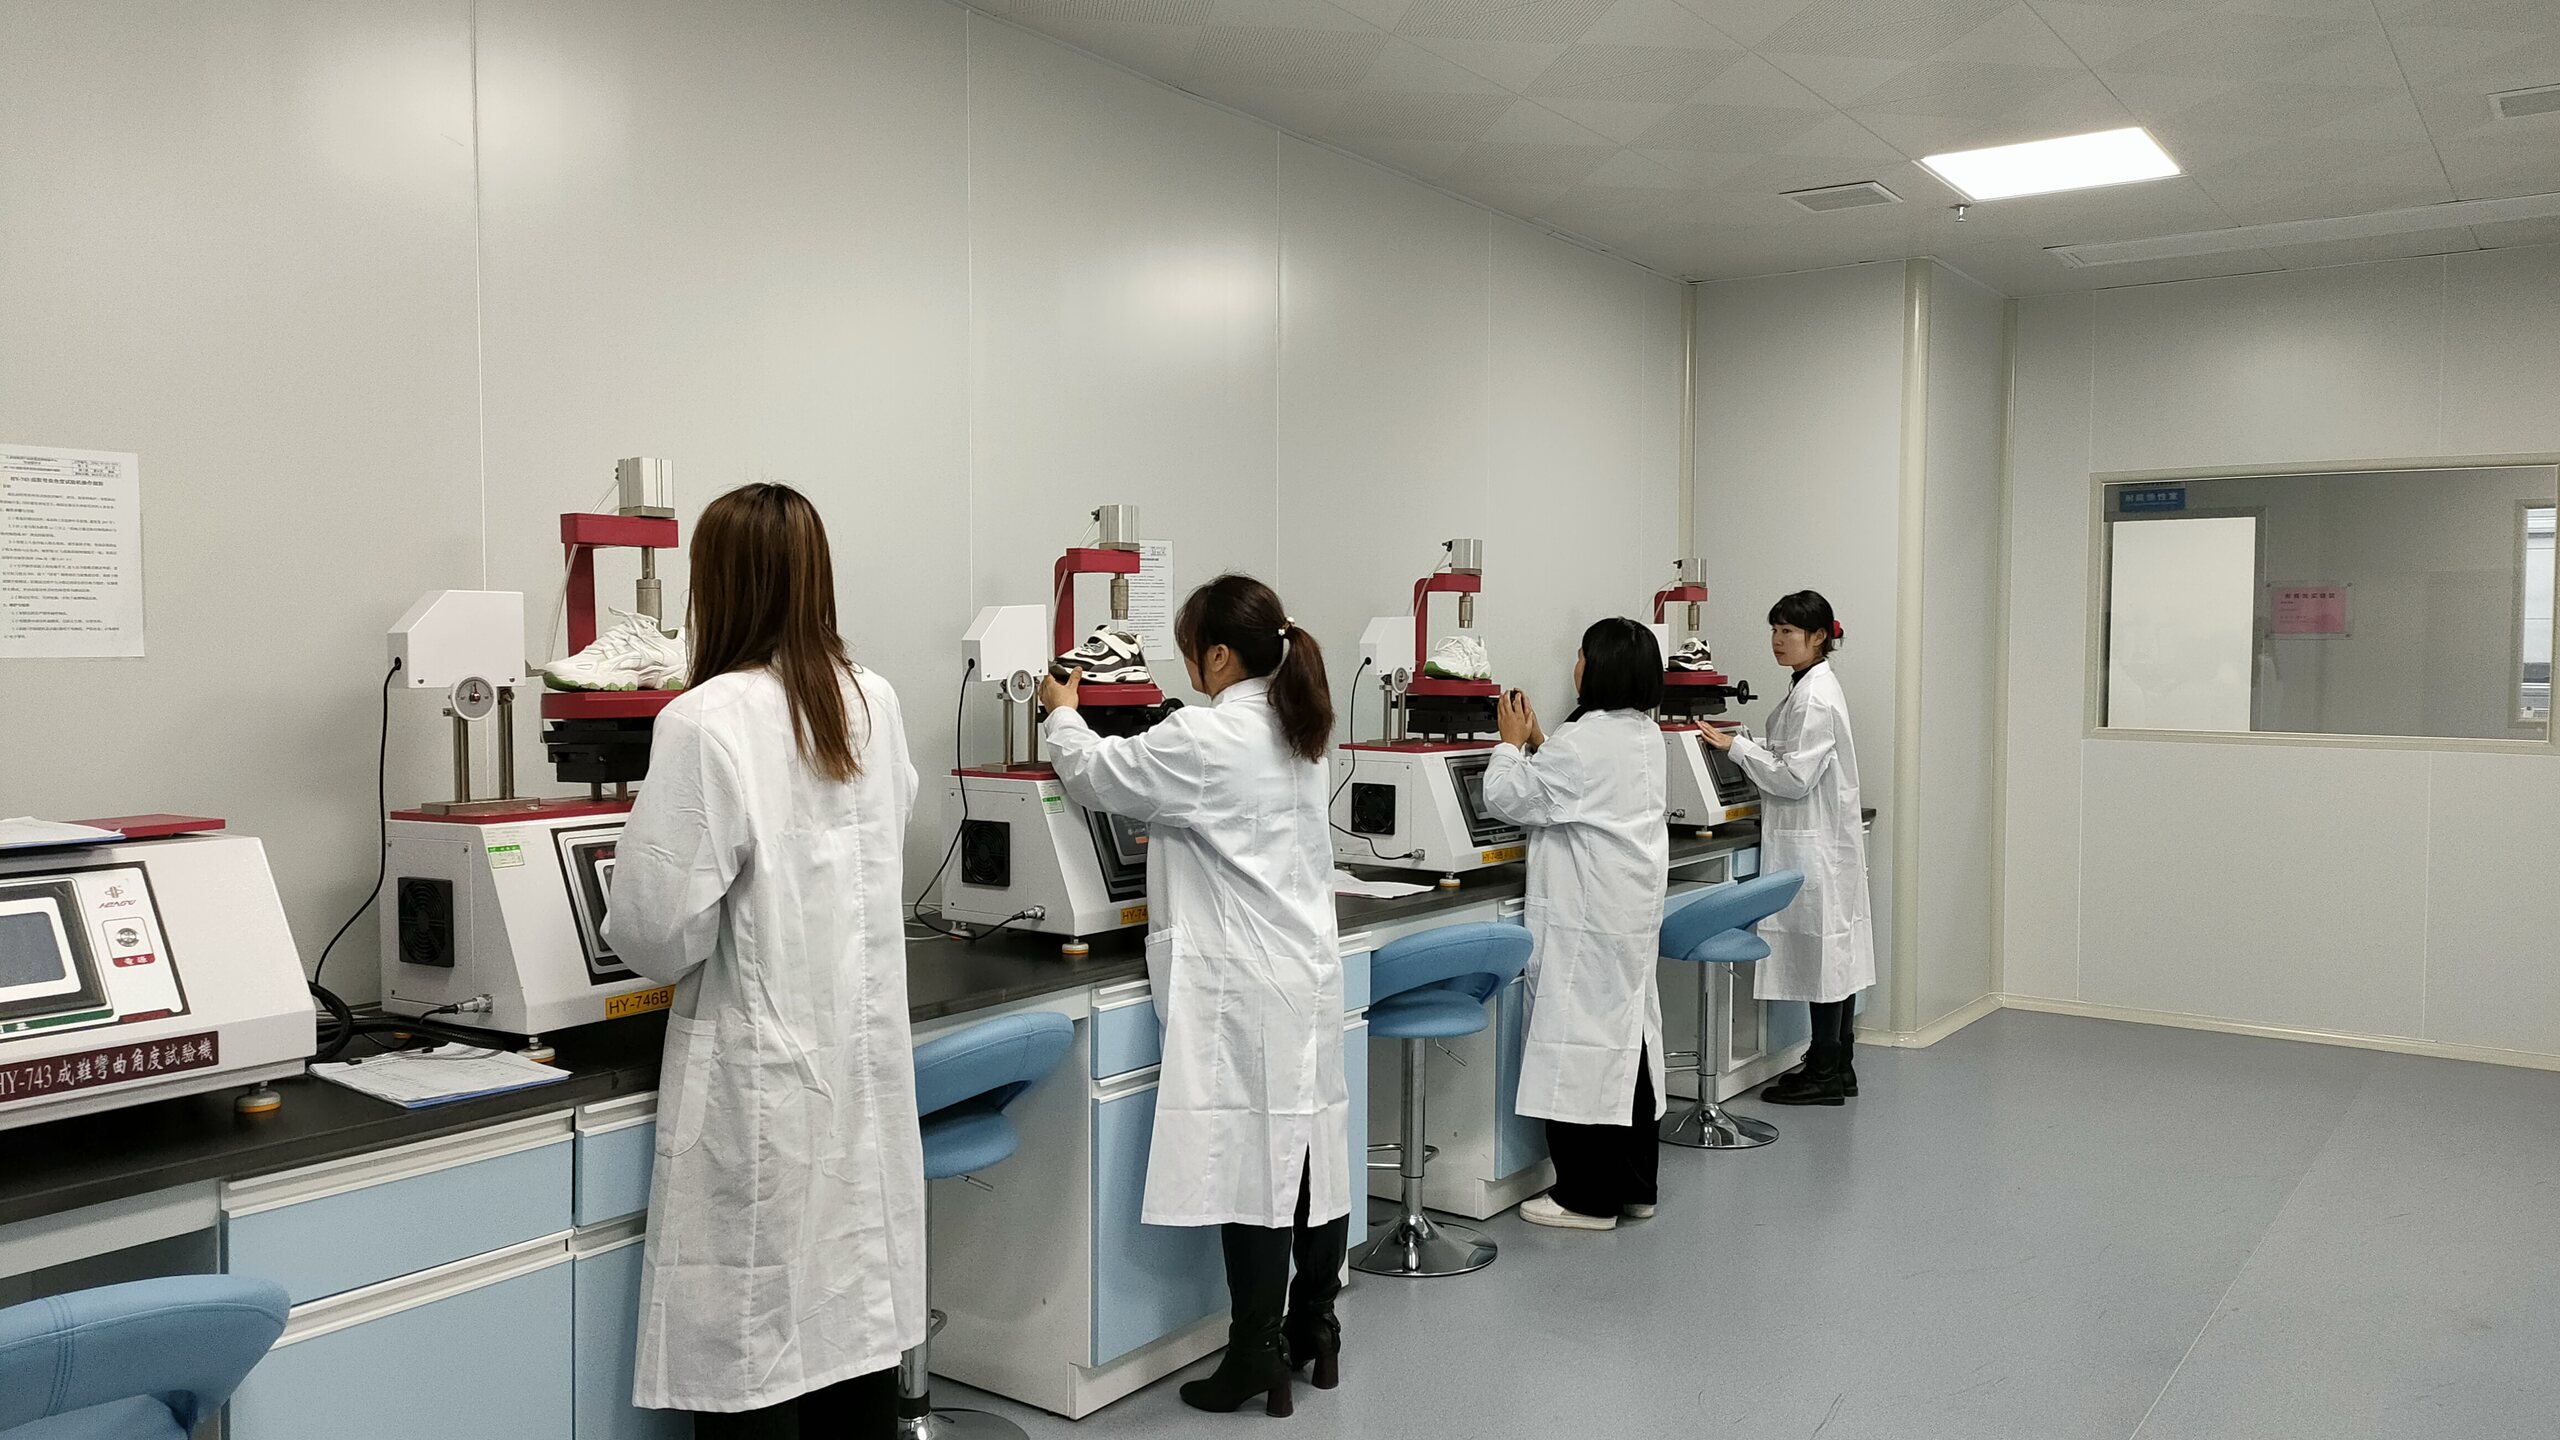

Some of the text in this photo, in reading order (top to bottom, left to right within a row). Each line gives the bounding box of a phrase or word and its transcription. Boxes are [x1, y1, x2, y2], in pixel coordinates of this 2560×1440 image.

[608, 990, 669, 1014] HY-746B
[57, 1037, 214, 1087] 成鞋彎曲角度試驗機
